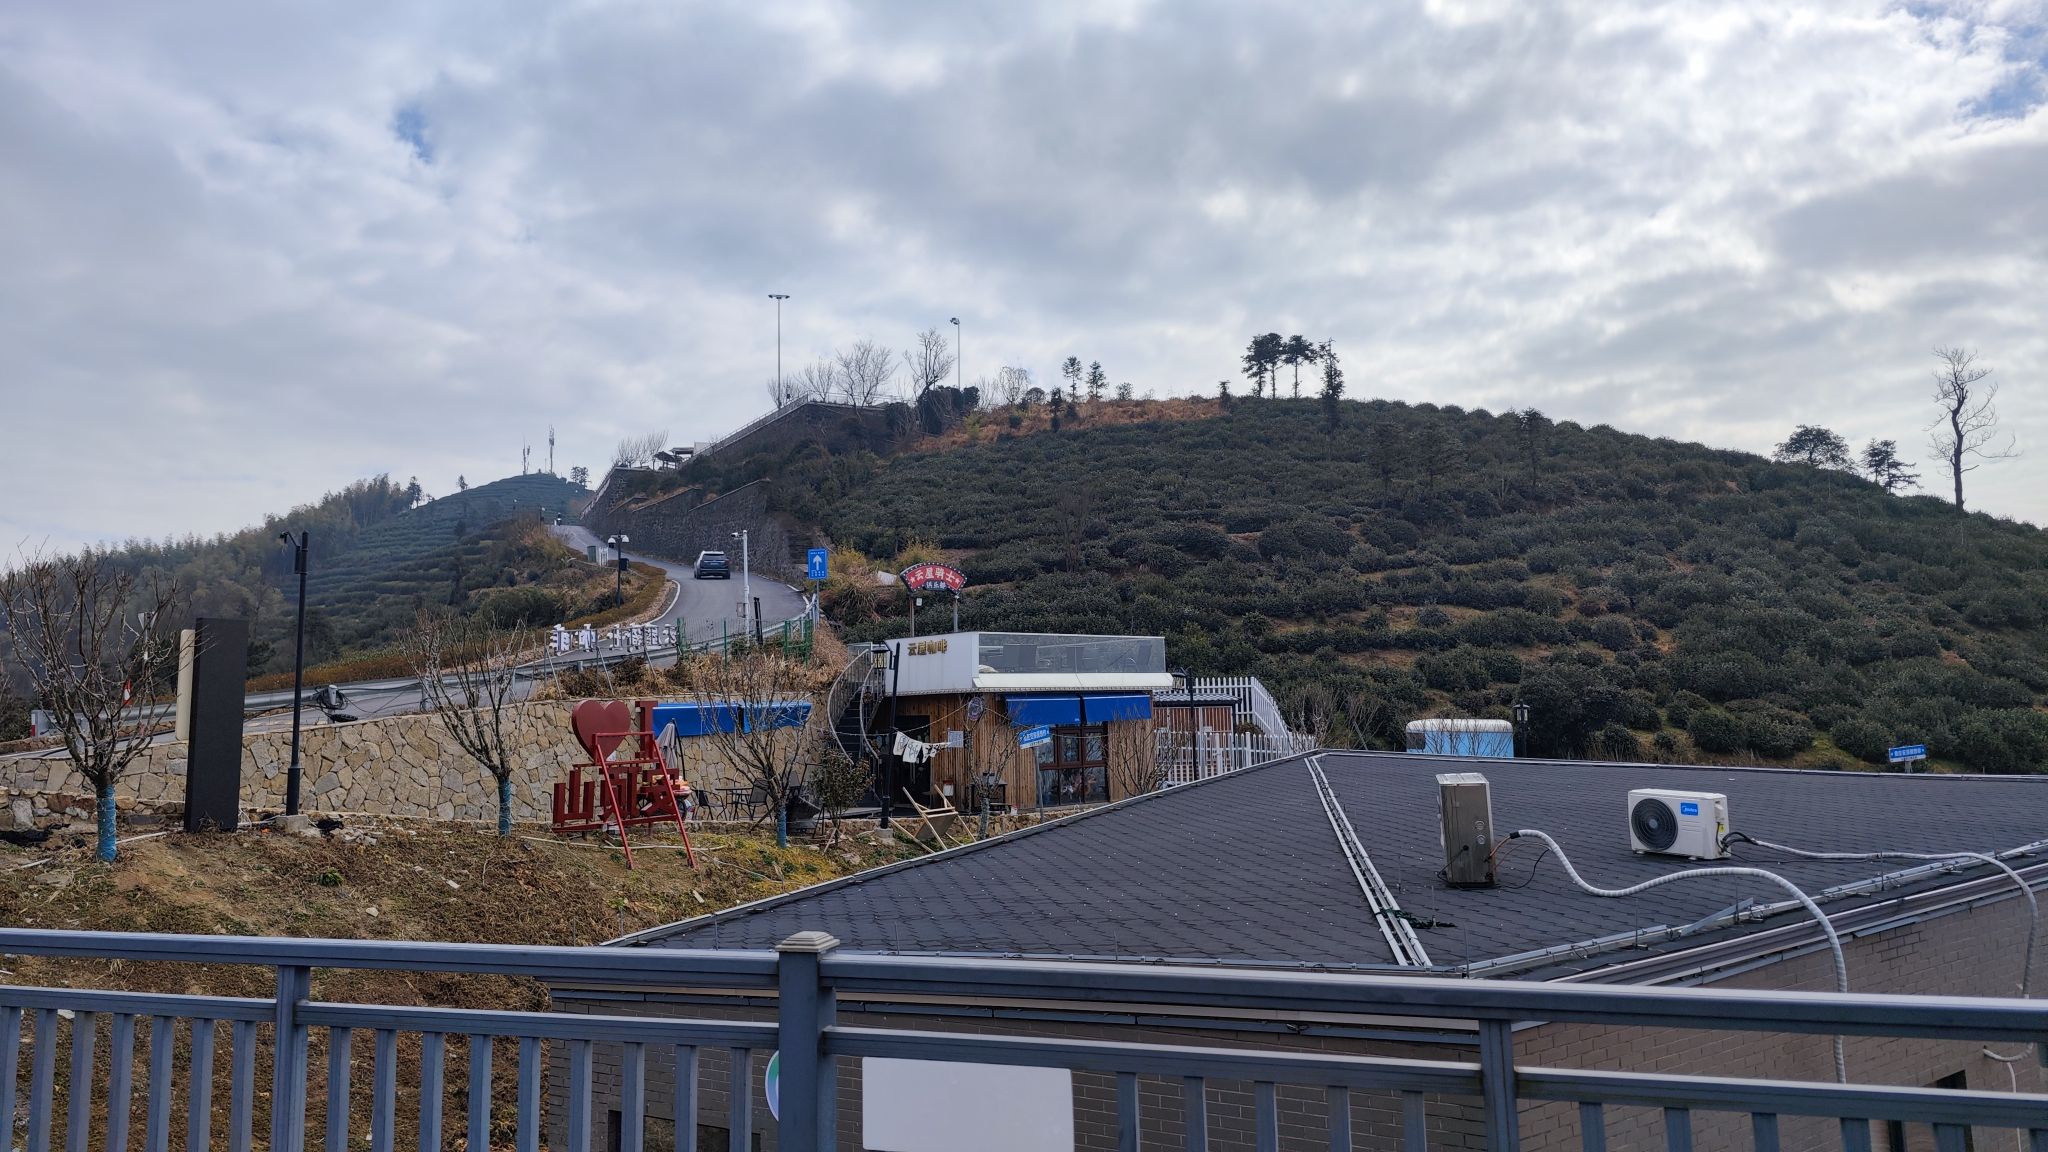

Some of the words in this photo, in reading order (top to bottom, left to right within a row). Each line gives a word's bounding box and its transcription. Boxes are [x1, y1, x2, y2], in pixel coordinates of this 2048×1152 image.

[915, 567, 955, 582] 云屋骑士
[907, 639, 947, 656] 云屋咖啡
